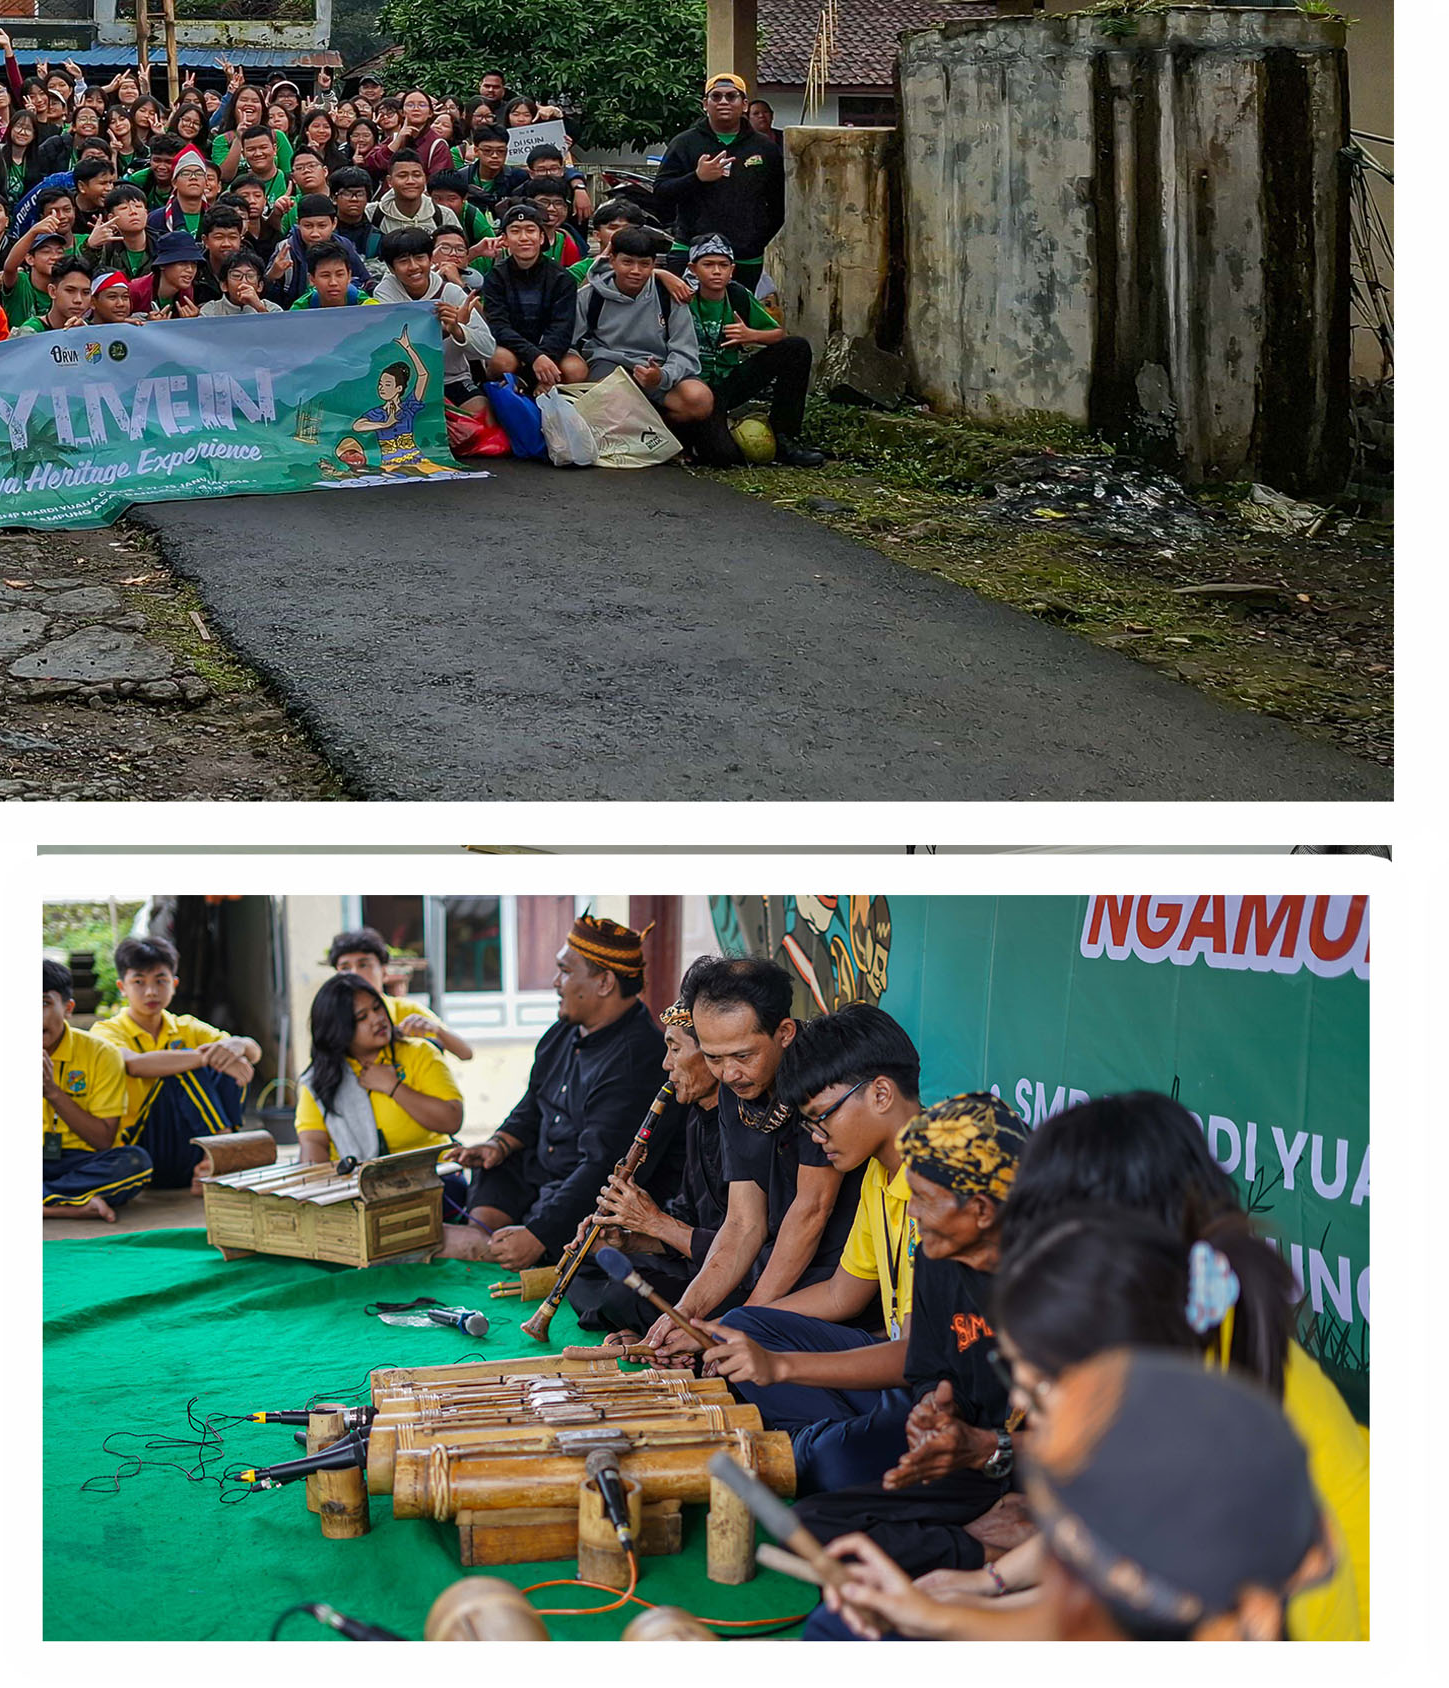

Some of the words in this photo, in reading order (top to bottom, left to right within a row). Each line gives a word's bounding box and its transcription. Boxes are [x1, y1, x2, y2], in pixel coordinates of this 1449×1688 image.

[50, 345, 79, 363] ORVA
[23, 459, 132, 493] Heritage
[136, 438, 263, 476] Experience
[38, 508, 92, 523] AMPUNG
[1086, 895, 1370, 963] NGAMU
